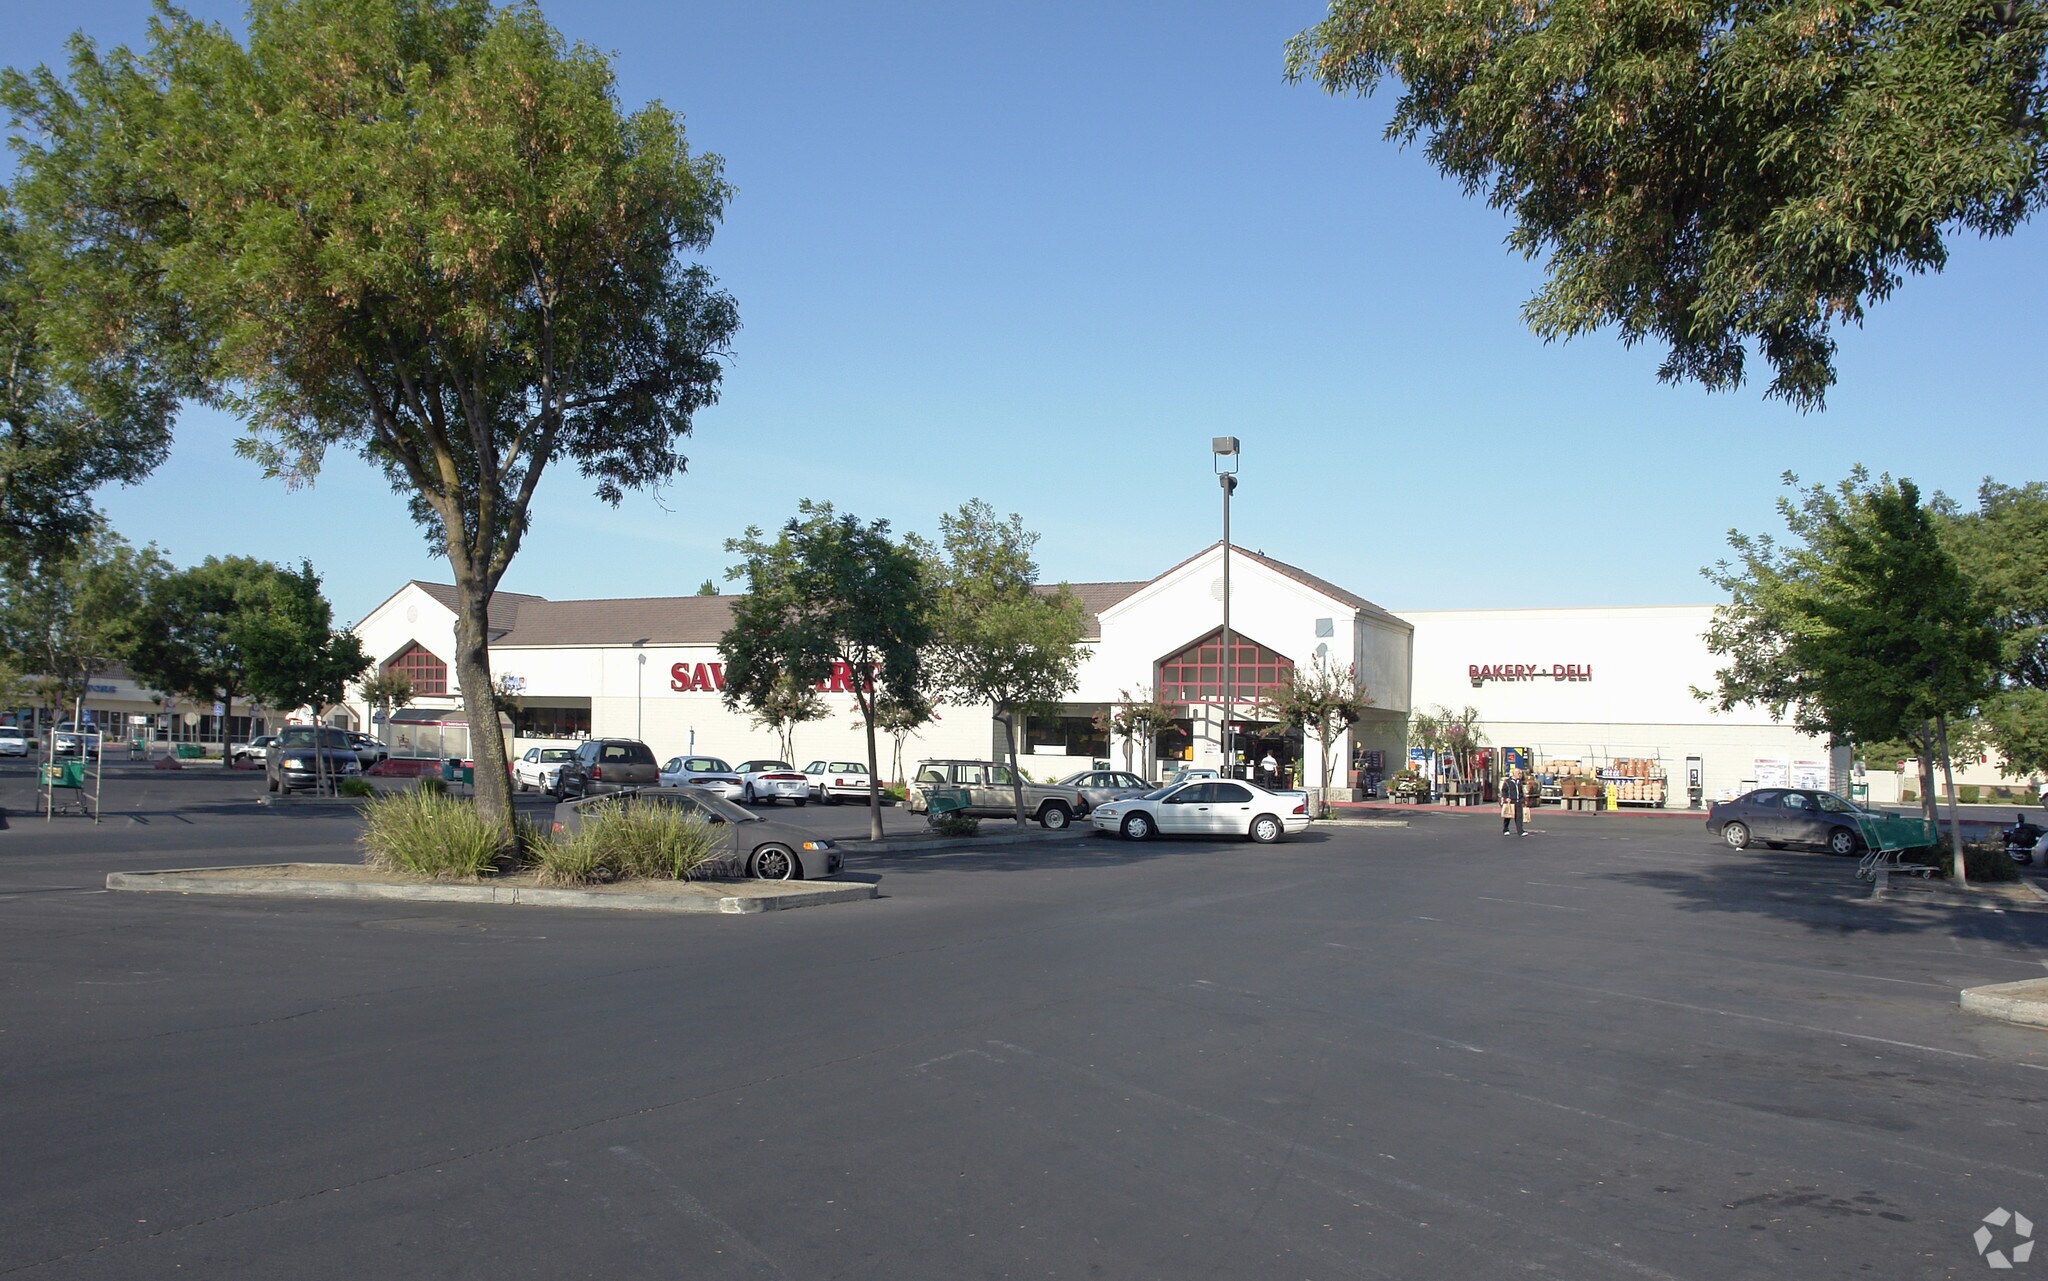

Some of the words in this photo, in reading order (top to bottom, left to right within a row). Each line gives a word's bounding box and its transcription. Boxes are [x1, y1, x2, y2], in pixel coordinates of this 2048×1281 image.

[670, 662, 729, 692] SAV
[1469, 664, 1537, 679] BAKERY
[1553, 664, 1592, 679] DELI
